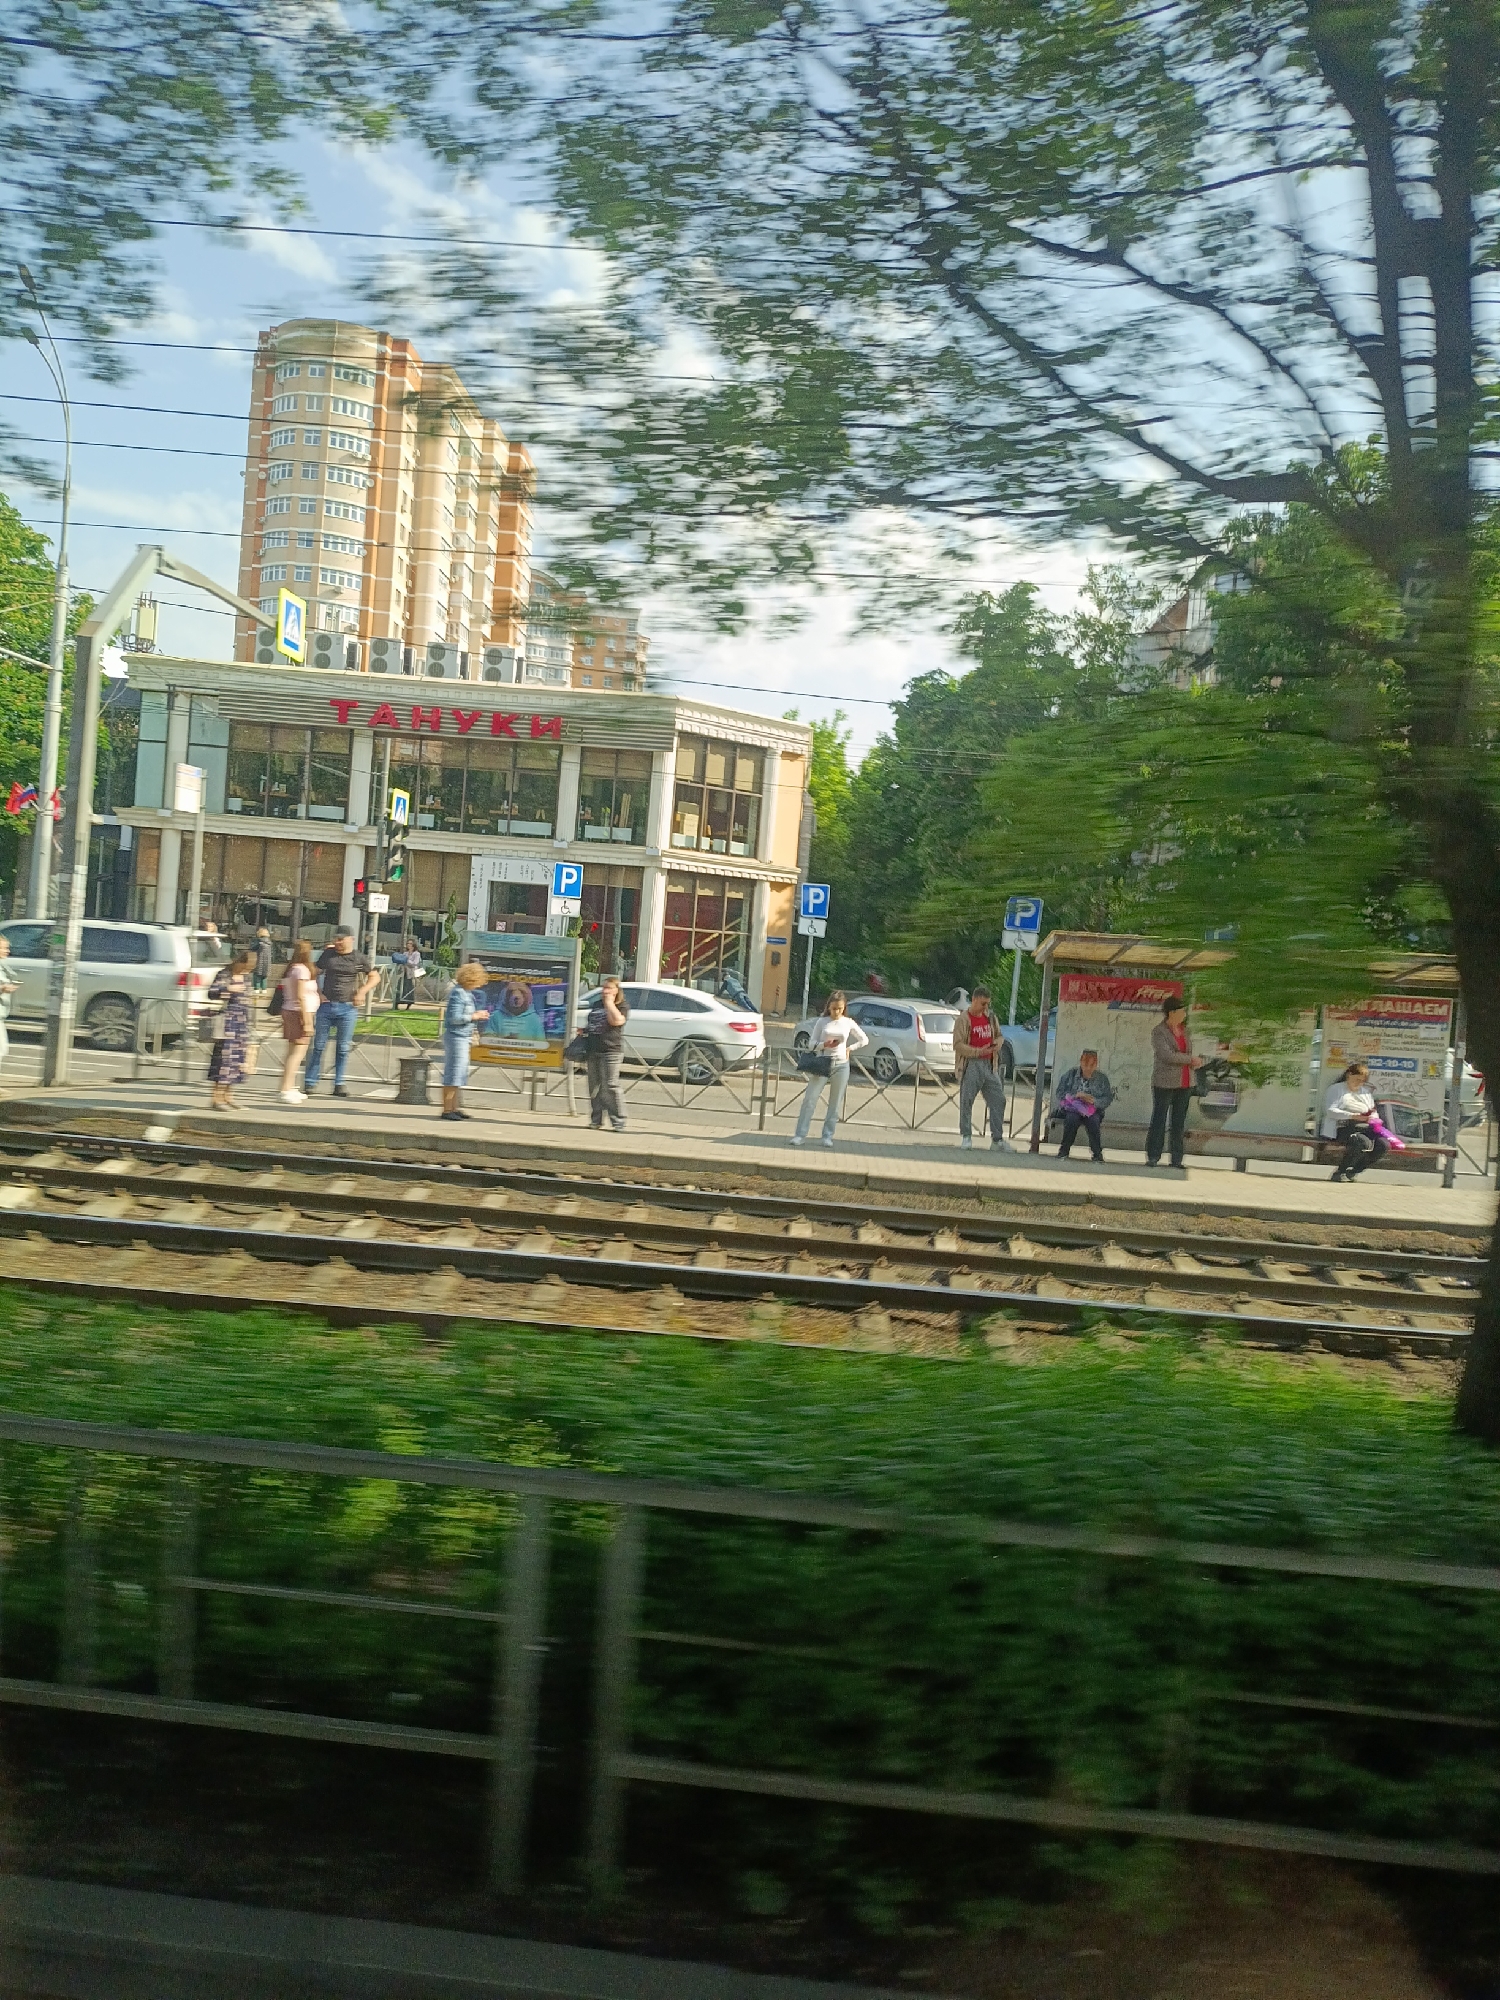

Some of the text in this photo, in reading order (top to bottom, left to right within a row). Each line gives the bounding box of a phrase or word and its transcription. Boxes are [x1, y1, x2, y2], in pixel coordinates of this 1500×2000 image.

[329, 699, 563, 740] ТАНУКИ
[560, 867, 578, 894] P
[808, 887, 825, 913] P
